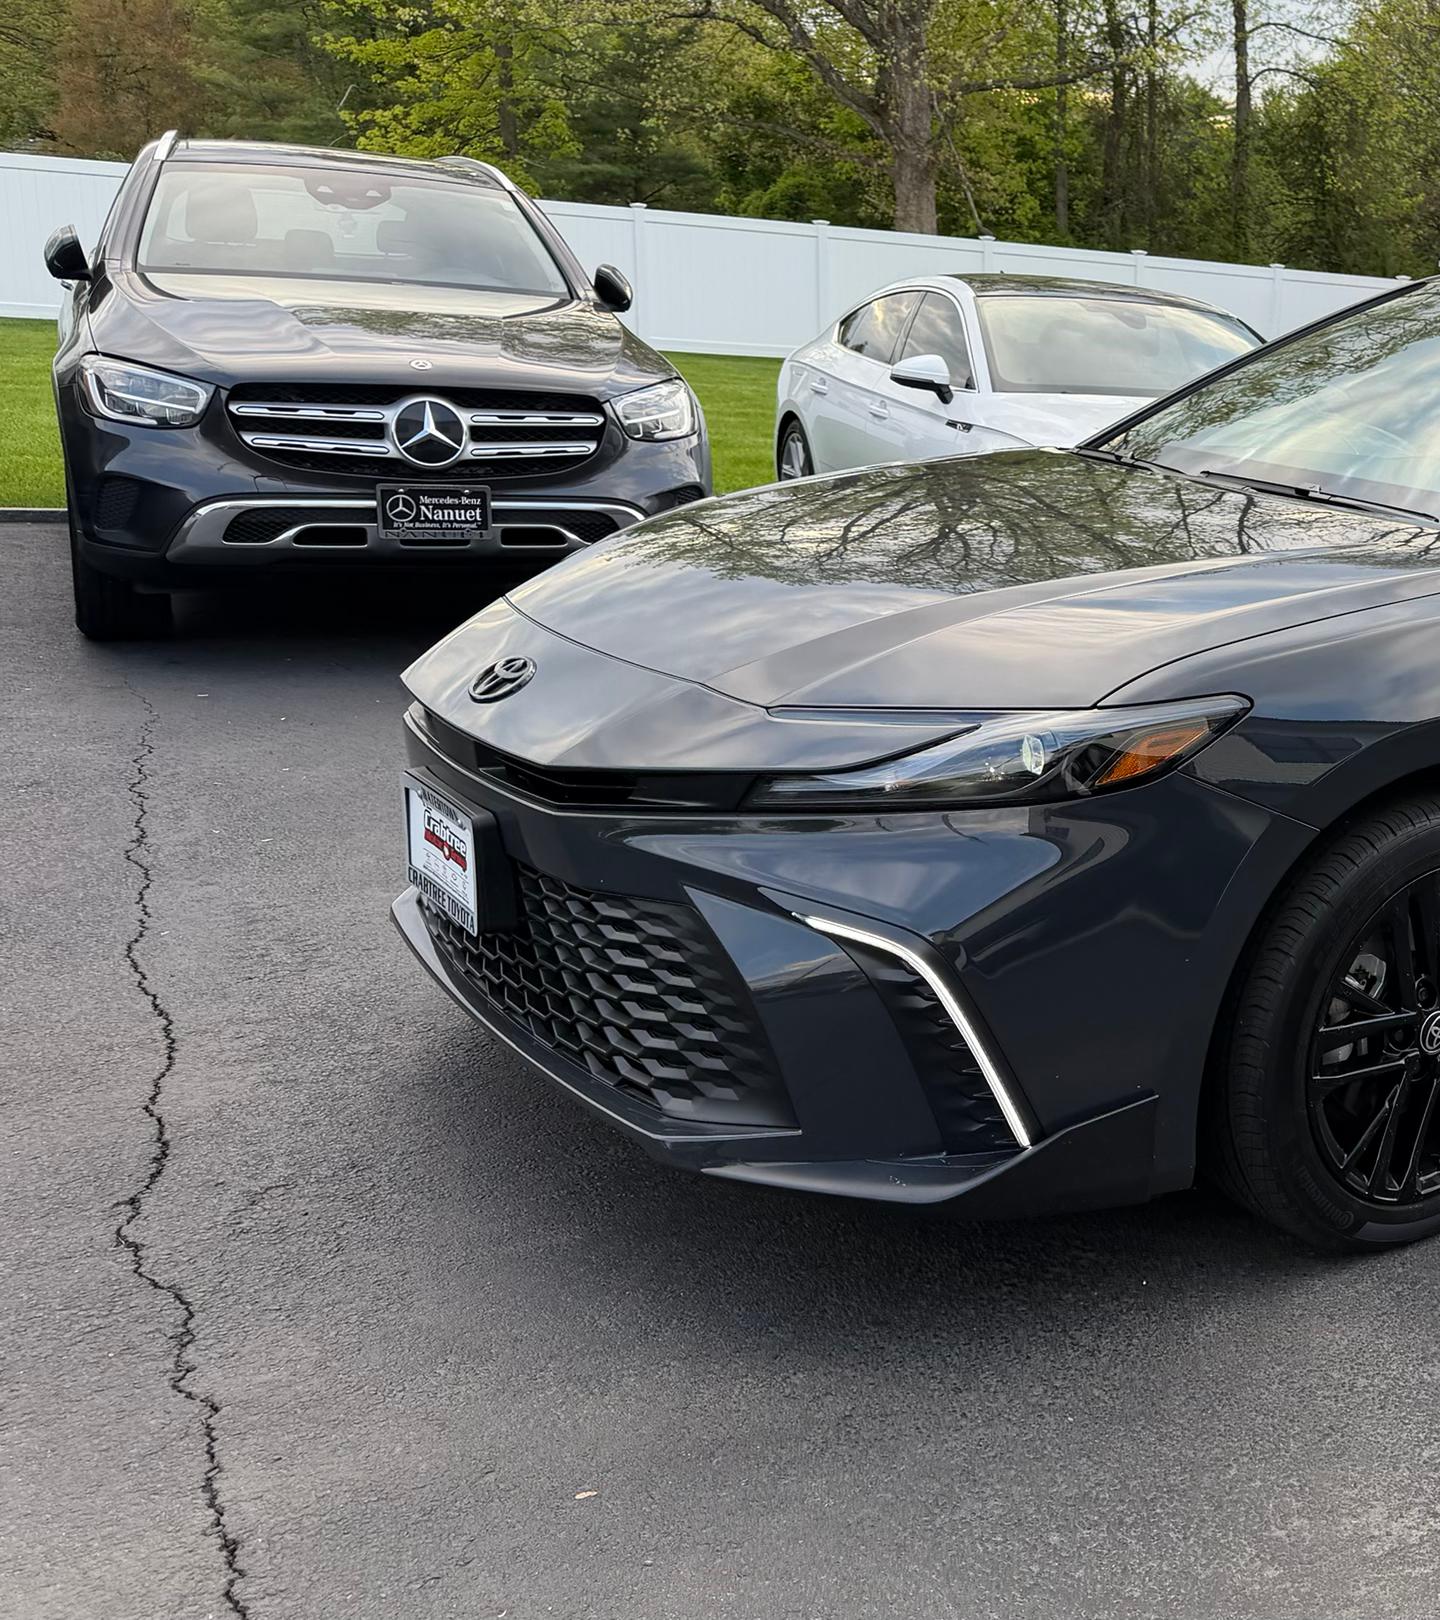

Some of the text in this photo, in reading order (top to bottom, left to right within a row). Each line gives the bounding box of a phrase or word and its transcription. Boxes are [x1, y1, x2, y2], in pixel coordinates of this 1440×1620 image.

[419, 495, 481, 505] Mercedes-Benz
[420, 505, 482, 521] Nanuet
[424, 807, 467, 858] Crabtree
[408, 866, 447, 909] CRABTREE
[447, 894, 476, 934] TOYOTA
